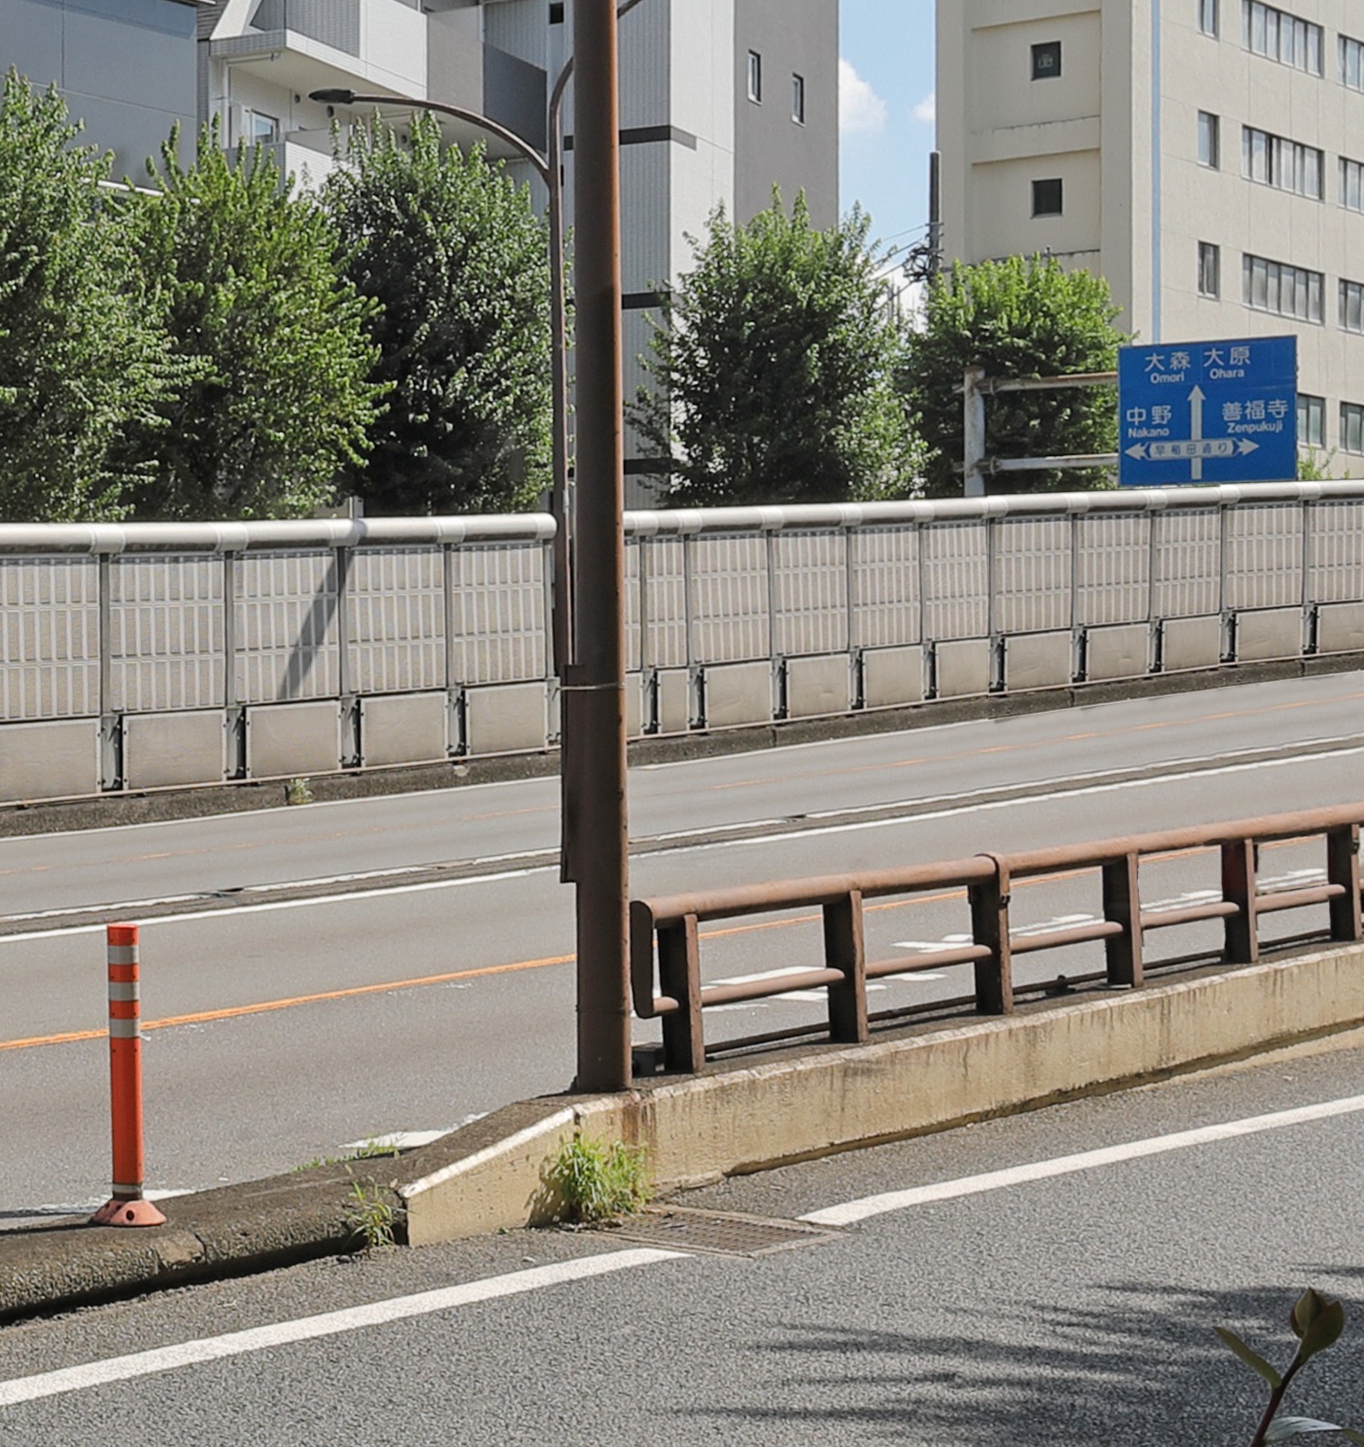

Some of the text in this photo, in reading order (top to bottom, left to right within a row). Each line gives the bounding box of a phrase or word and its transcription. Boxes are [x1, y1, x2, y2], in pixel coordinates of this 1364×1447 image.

[1144, 345, 1251, 372] 大森 大原
[1150, 368, 1245, 384] Omori Ohara
[1126, 405, 1172, 426] 中野
[1222, 399, 1289, 421] 善福寺
[1128, 427, 1170, 438] Nakano
[1227, 420, 1283, 434] Zenpukuji
